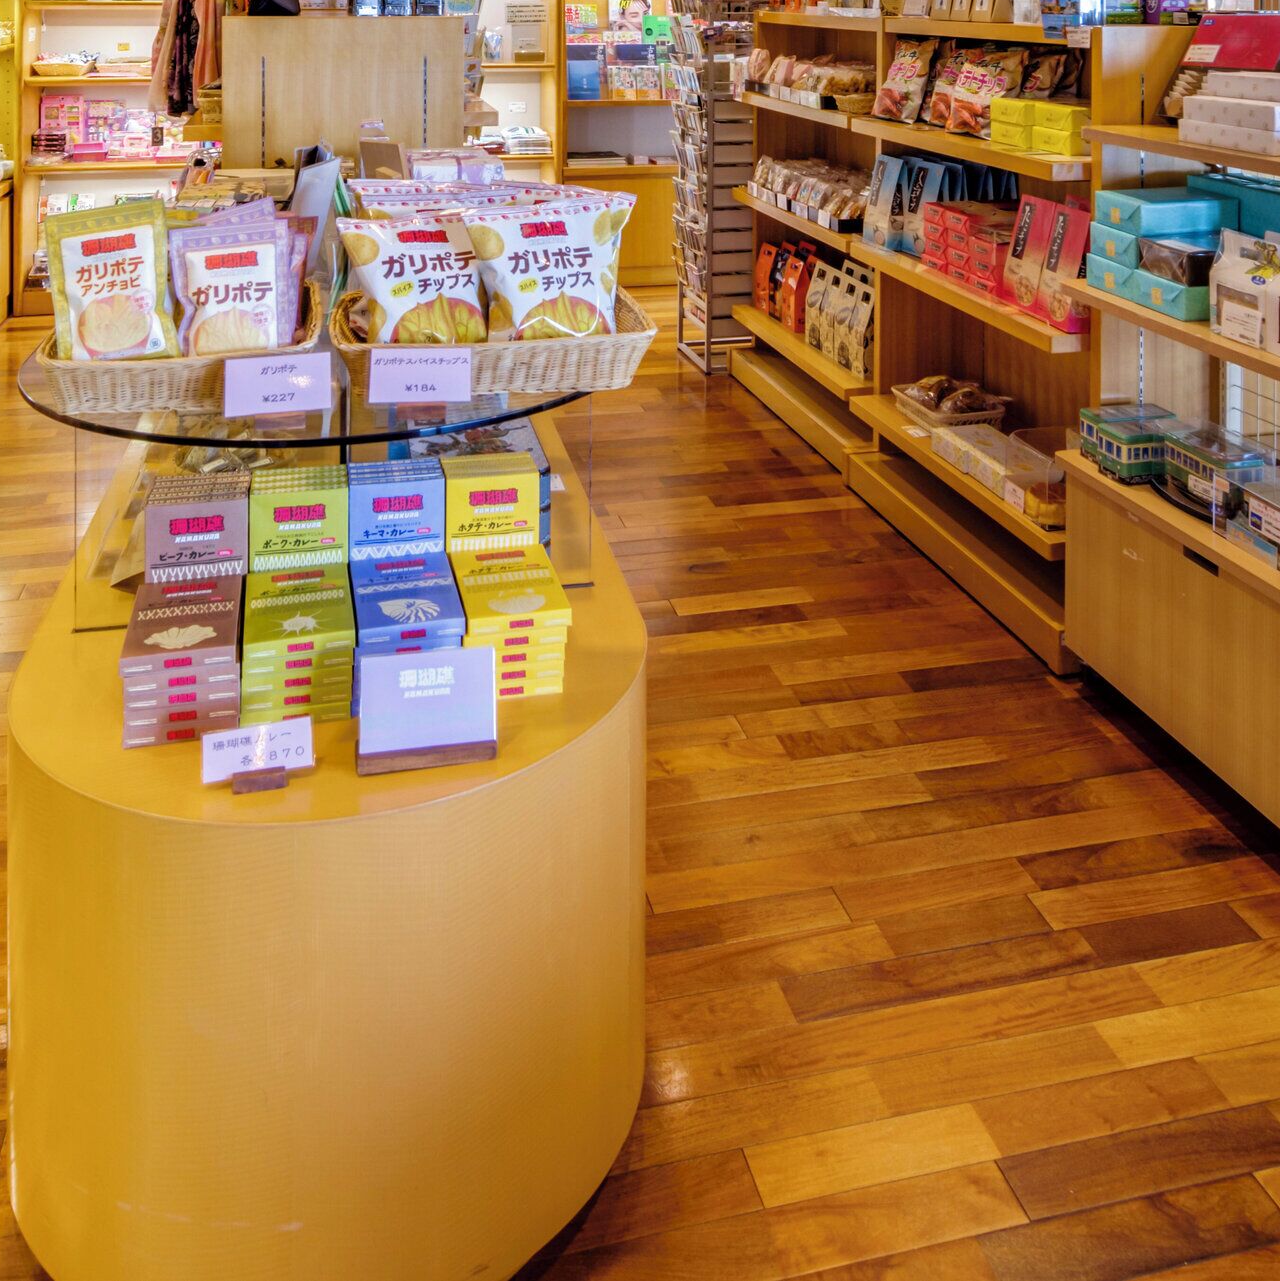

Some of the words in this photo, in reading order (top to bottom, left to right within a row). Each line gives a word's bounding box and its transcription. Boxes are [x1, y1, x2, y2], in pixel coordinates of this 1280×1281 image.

[76, 256, 144, 285] ガリポテ
[382, 250, 476, 279] ガリポテ
[508, 246, 593, 275] ガリポテ
[80, 275, 141, 298] アンチョビ
[418, 273, 476, 295] チップス
[541, 271, 595, 293] チップス
[191, 280, 274, 307] ガリポテ
[260, 363, 297, 376] ガリポテ
[374, 356, 469, 366] ガリポテスパイスチップス
[261, 392, 296, 403] ¥227
[404, 383, 437, 393] ¥184
[240, 745, 305, 767] 各870
